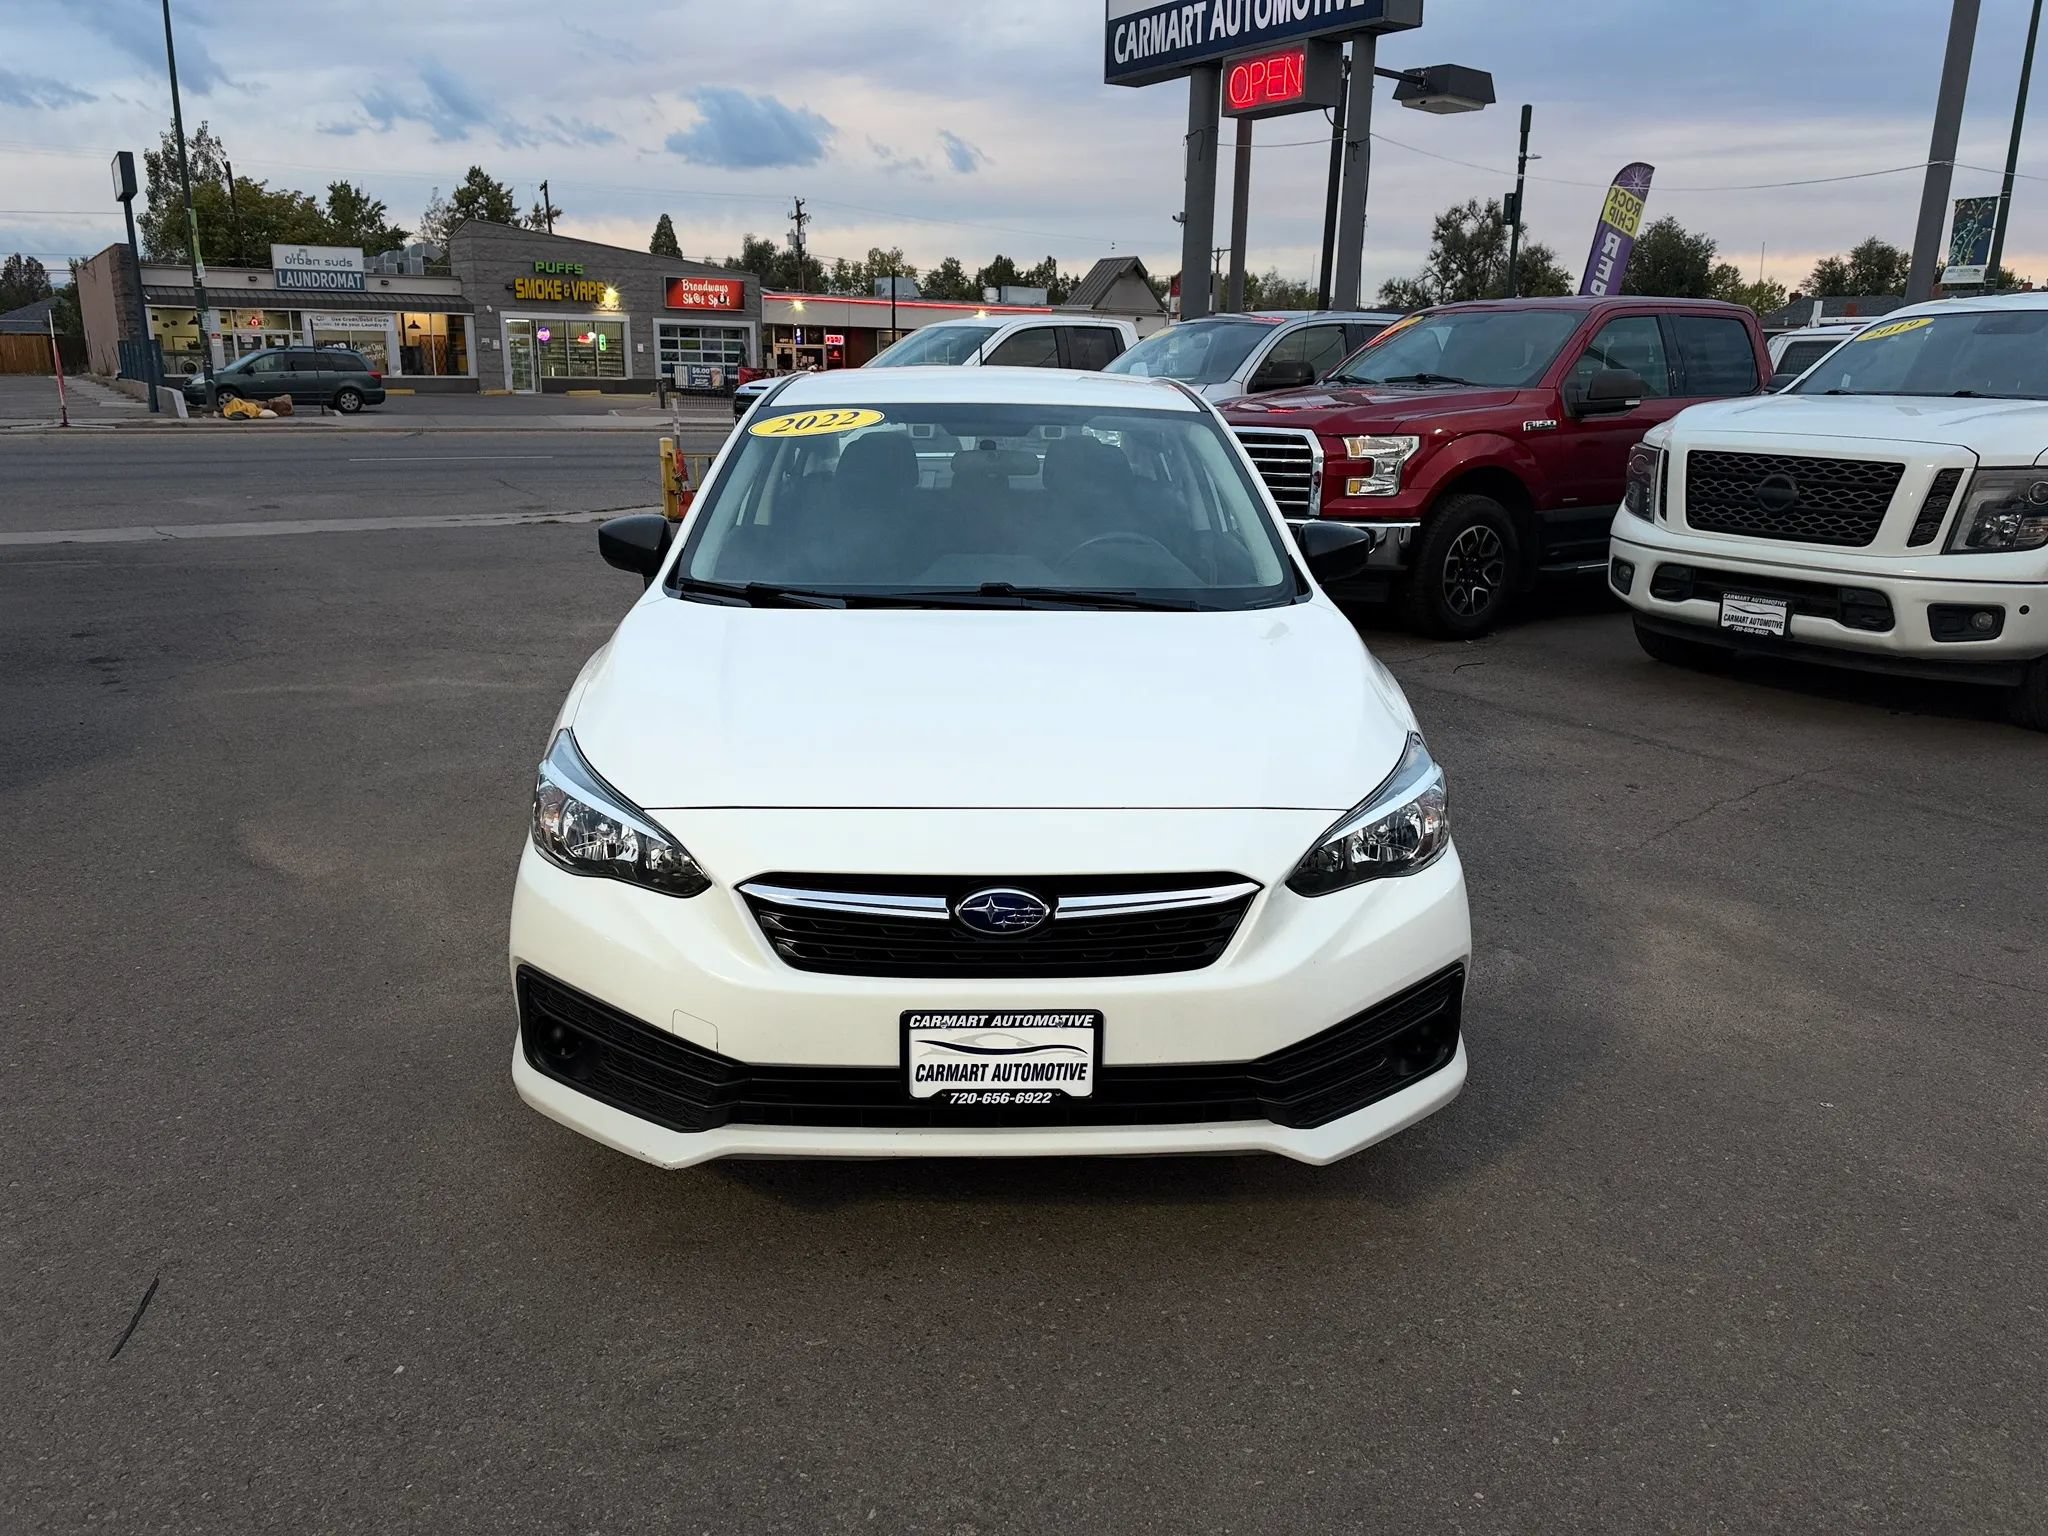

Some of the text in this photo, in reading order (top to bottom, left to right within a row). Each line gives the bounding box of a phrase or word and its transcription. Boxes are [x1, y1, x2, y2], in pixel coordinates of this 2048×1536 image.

[1114, 0, 1365, 64] CARMART AUTOM
[1229, 54, 1304, 104] OPEN
[324, 257, 353, 268] suds
[534, 261, 584, 275] PUFFS
[278, 271, 362, 289] LAUNDROMAT
[681, 279, 729, 293] Broadways
[515, 278, 562, 300] SMOKE
[563, 283, 571, 297] &
[769, 411, 861, 433] 2022
[1723, 593, 1750, 602] CARMART
[1724, 614, 1783, 629] CARMART AUTOMOTIVE
[909, 1014, 1095, 1028] CARMART AUTOMOTIVE
[915, 1062, 1088, 1082] CARMART AUTOMOTIVE
[949, 1091, 1053, 1105] 720-656-6922
